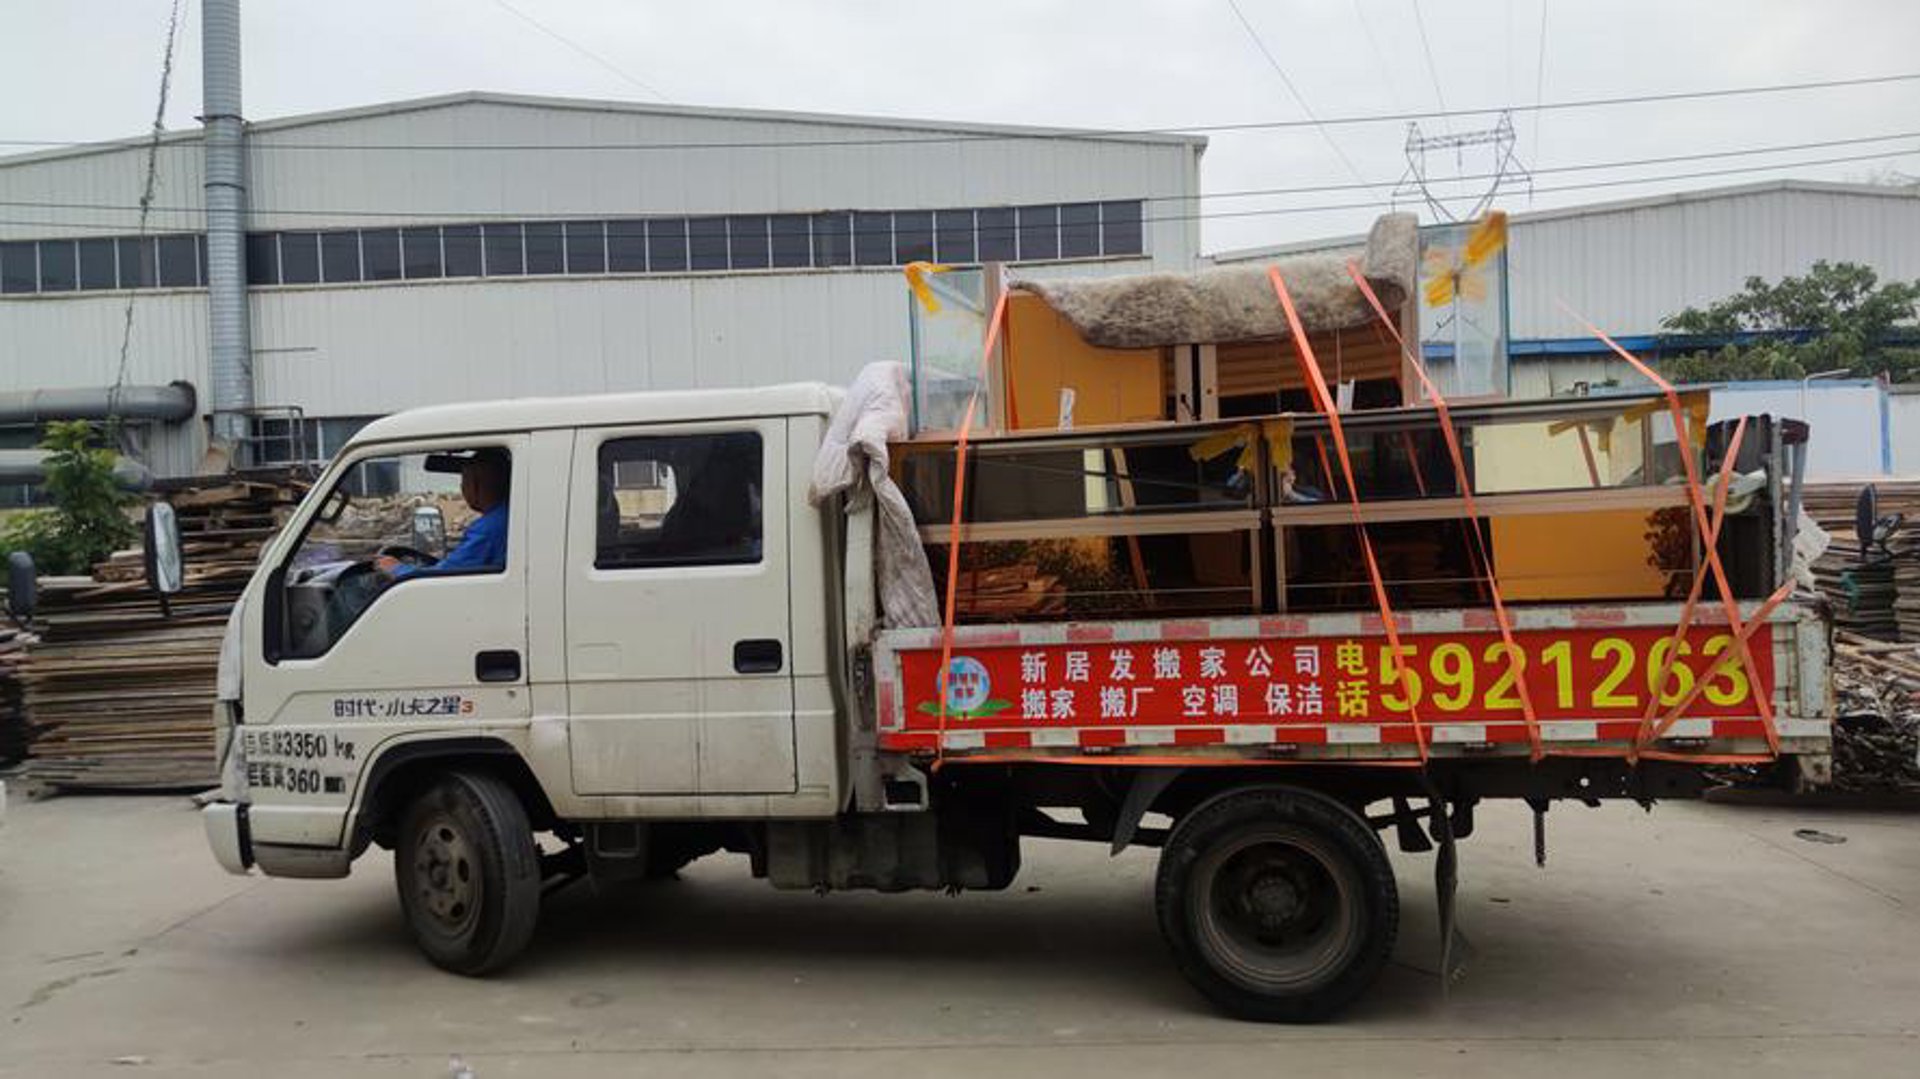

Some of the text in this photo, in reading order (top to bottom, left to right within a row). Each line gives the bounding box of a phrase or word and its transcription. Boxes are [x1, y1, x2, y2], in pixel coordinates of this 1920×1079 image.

[1021, 645, 1320, 683] 新居发搬家公司
[1336, 640, 1370, 717] 电话
[1379, 636, 1749, 711] 5921263
[1021, 682, 1323, 719] 搬家 搬厂 空调 保洁
